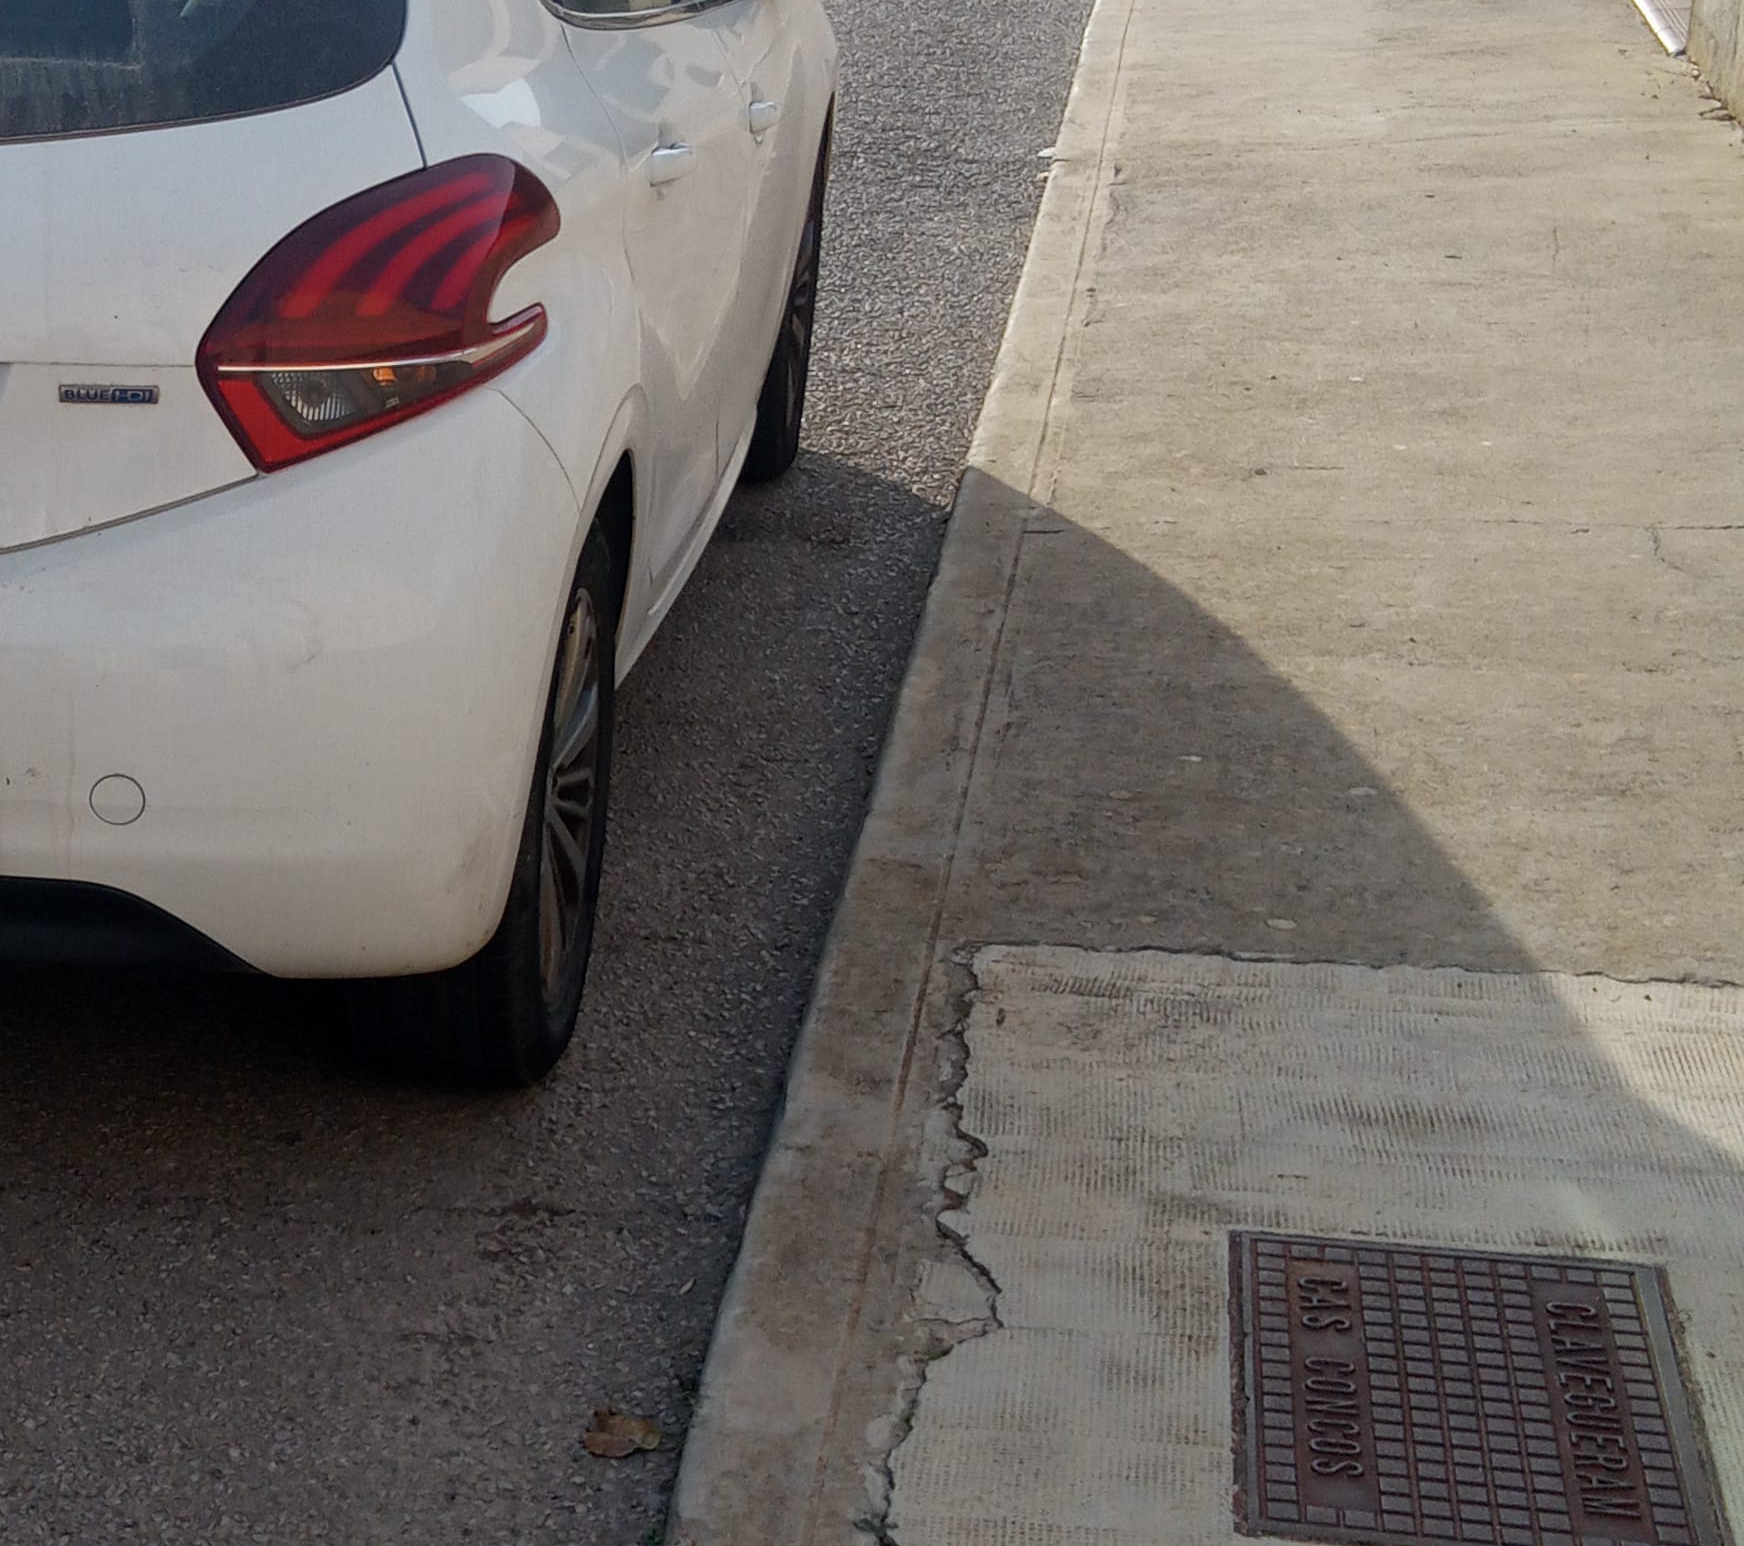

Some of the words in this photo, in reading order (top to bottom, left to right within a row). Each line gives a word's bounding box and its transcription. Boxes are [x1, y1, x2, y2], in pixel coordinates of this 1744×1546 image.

[1297, 1277, 1353, 1333] CAS
[1303, 1357, 1366, 1479] CONCOS
[1544, 1300, 1642, 1520] CLAVEGUERAM
